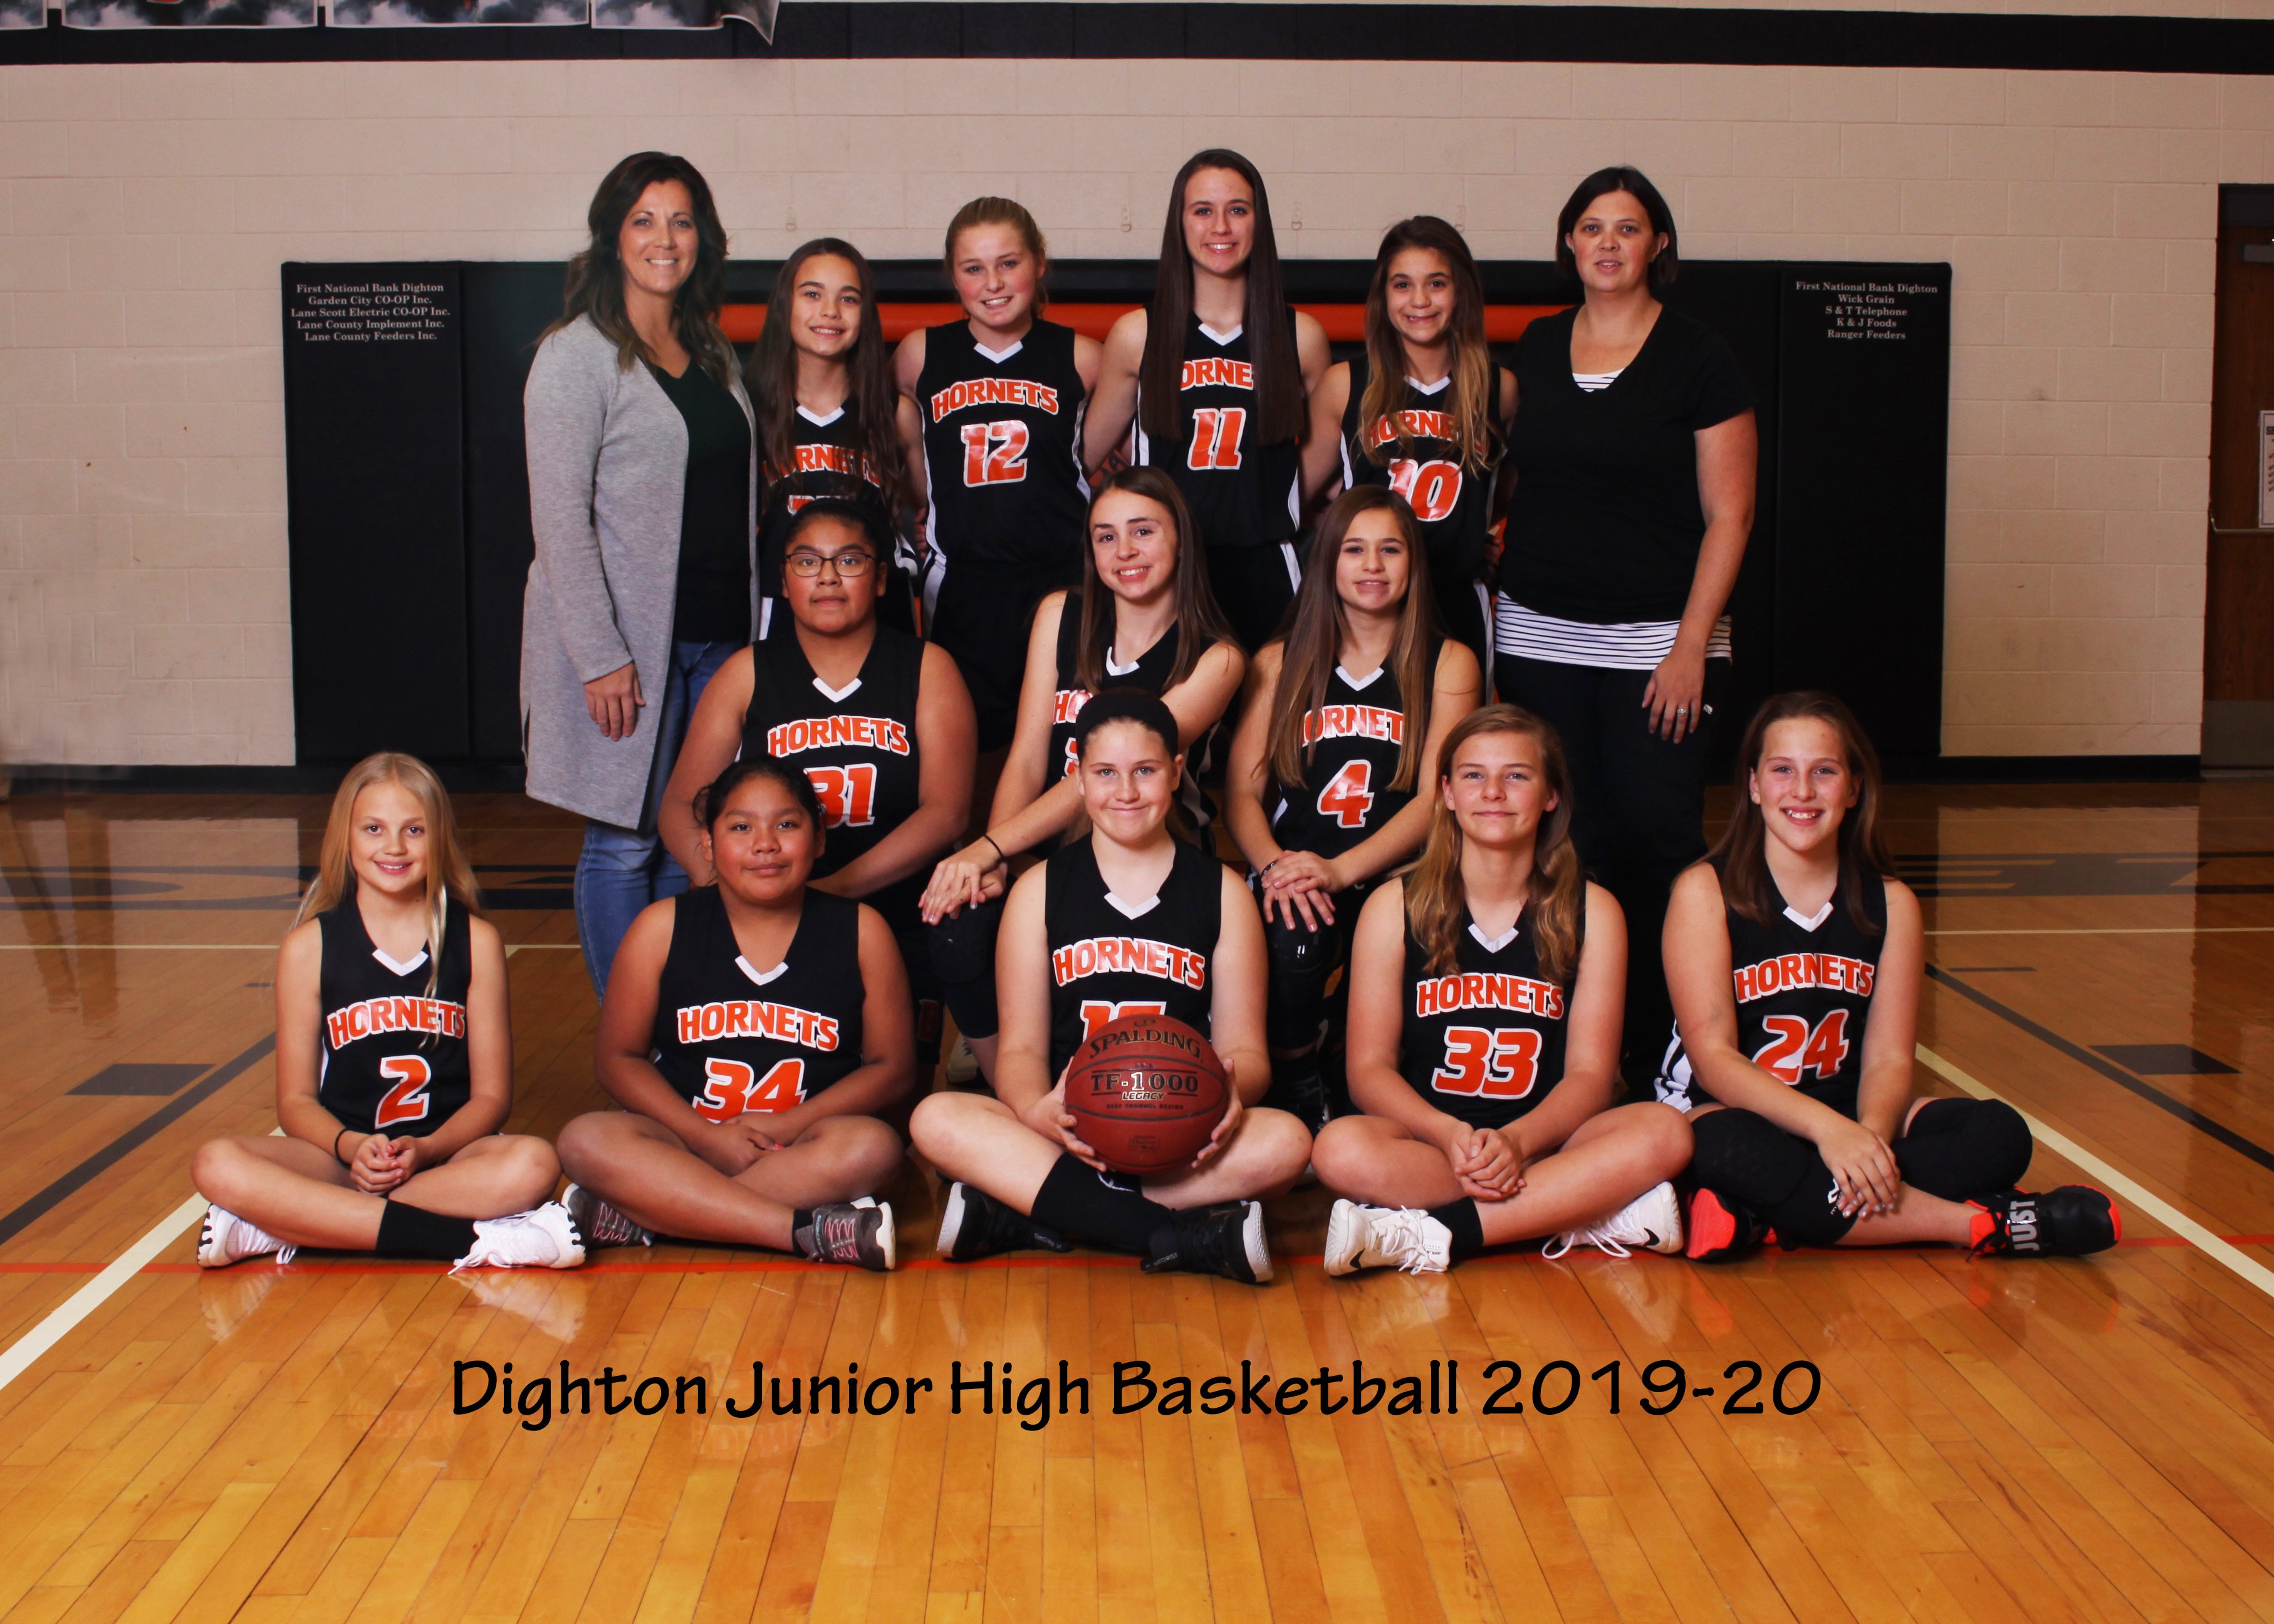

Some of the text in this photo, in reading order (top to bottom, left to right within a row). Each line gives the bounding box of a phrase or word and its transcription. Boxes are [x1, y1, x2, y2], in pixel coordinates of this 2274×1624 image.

[291, 307, 450, 317] Lane Scott Electric CO-OP Inc.
[296, 283, 444, 294] First National Bank Dighton
[308, 295, 432, 306] Garden City CO-OP Inc.
[1796, 282, 1938, 294] First National Bank Dighton
[1825, 306, 1907, 317] S & T Telephone
[1838, 294, 1895, 304] Wick Grain
[297, 319, 445, 330] Lane County Implement Inc.
[305, 331, 437, 342] Lane County Feeders Inc.
[1827, 330, 1906, 340] Ranger Feeders
[1837, 318, 1897, 328] K & J Foods
[931, 378, 1058, 423] HORNETS
[960, 420, 1030, 487] 12
[1187, 408, 1246, 471] 11
[1387, 459, 1463, 522] 10
[767, 715, 910, 758] HORNETS
[803, 763, 877, 830] 31
[1317, 759, 1375, 828] 4
[1053, 937, 1205, 991] HORNETS
[1733, 953, 1875, 1003] HORNETS
[1416, 972, 1564, 1020] HORNETS
[326, 996, 466, 1050] HORNETS
[677, 1001, 840, 1051] HORNETS
[1089, 1029, 1202, 1059] SPALDING
[1752, 1008, 1849, 1085] 24
[1431, 1026, 1542, 1100] 33
[375, 1054, 432, 1129] 2
[692, 1057, 808, 1124] 34
[1121, 1091, 1167, 1101] LEGACY
[2010, 1200, 2040, 1251] JUST
